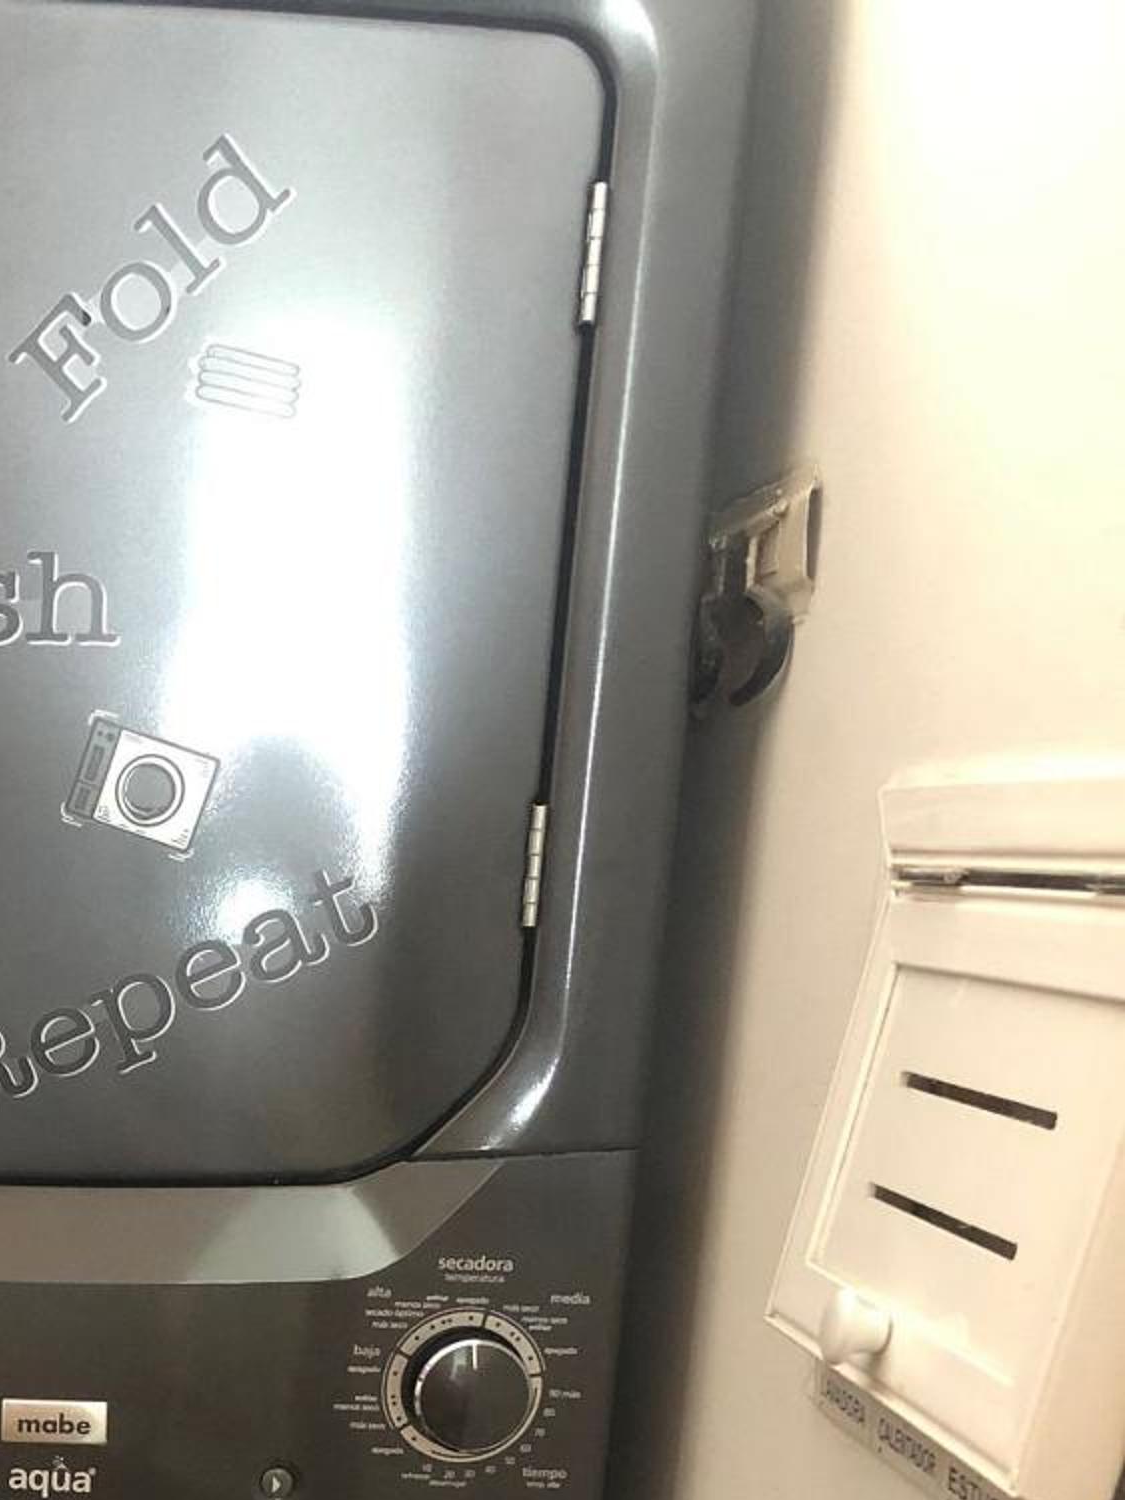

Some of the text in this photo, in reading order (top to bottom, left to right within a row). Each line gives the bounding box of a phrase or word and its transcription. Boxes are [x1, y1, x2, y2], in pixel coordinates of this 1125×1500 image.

[7, 133, 296, 424] Fold
[437, 1254, 515, 1273] secadora
[366, 1284, 393, 1299] alta
[550, 1292, 592, 1306] media
[17, 1412, 92, 1435] mabe
[8, 1464, 93, 1498] aqua
[522, 1466, 568, 1481] tiempo
